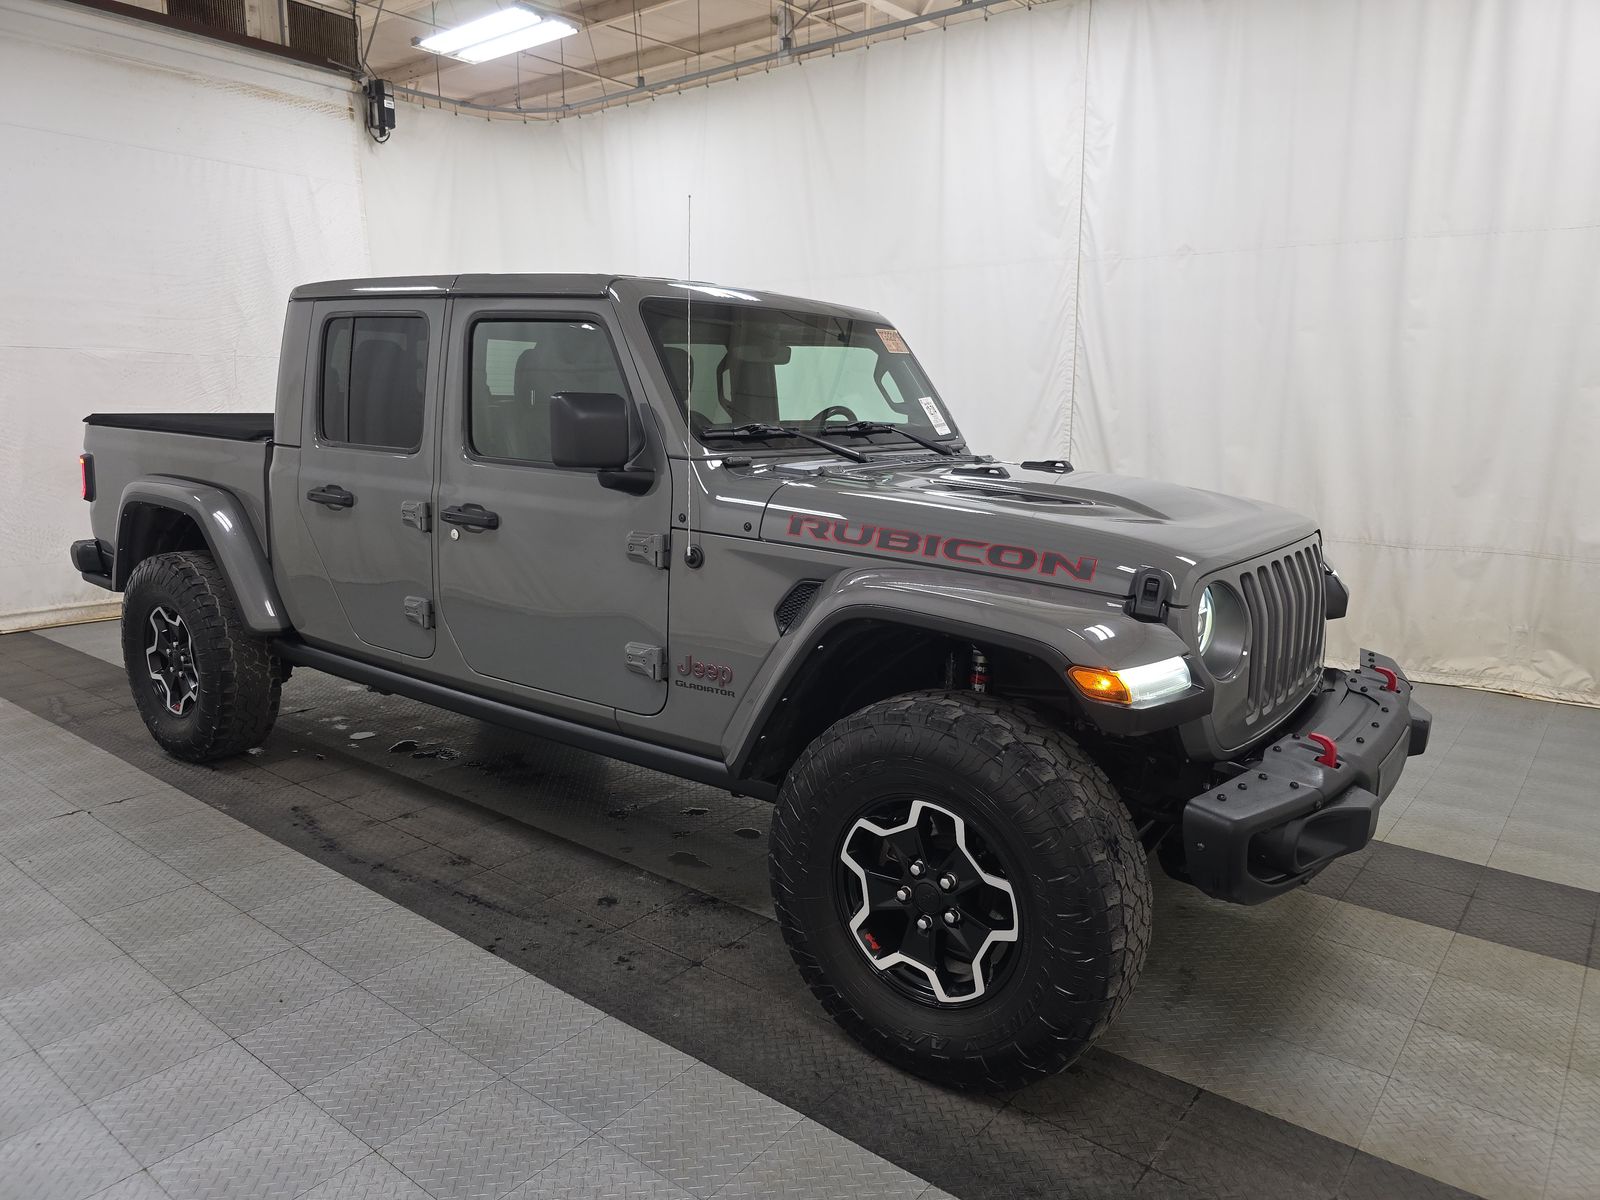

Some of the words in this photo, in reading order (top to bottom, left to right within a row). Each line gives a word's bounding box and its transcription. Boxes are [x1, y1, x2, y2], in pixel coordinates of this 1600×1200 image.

[787, 514, 1097, 582] RUBICON
[677, 655, 733, 688] Jeep
[675, 680, 736, 697] GLADIATOR
